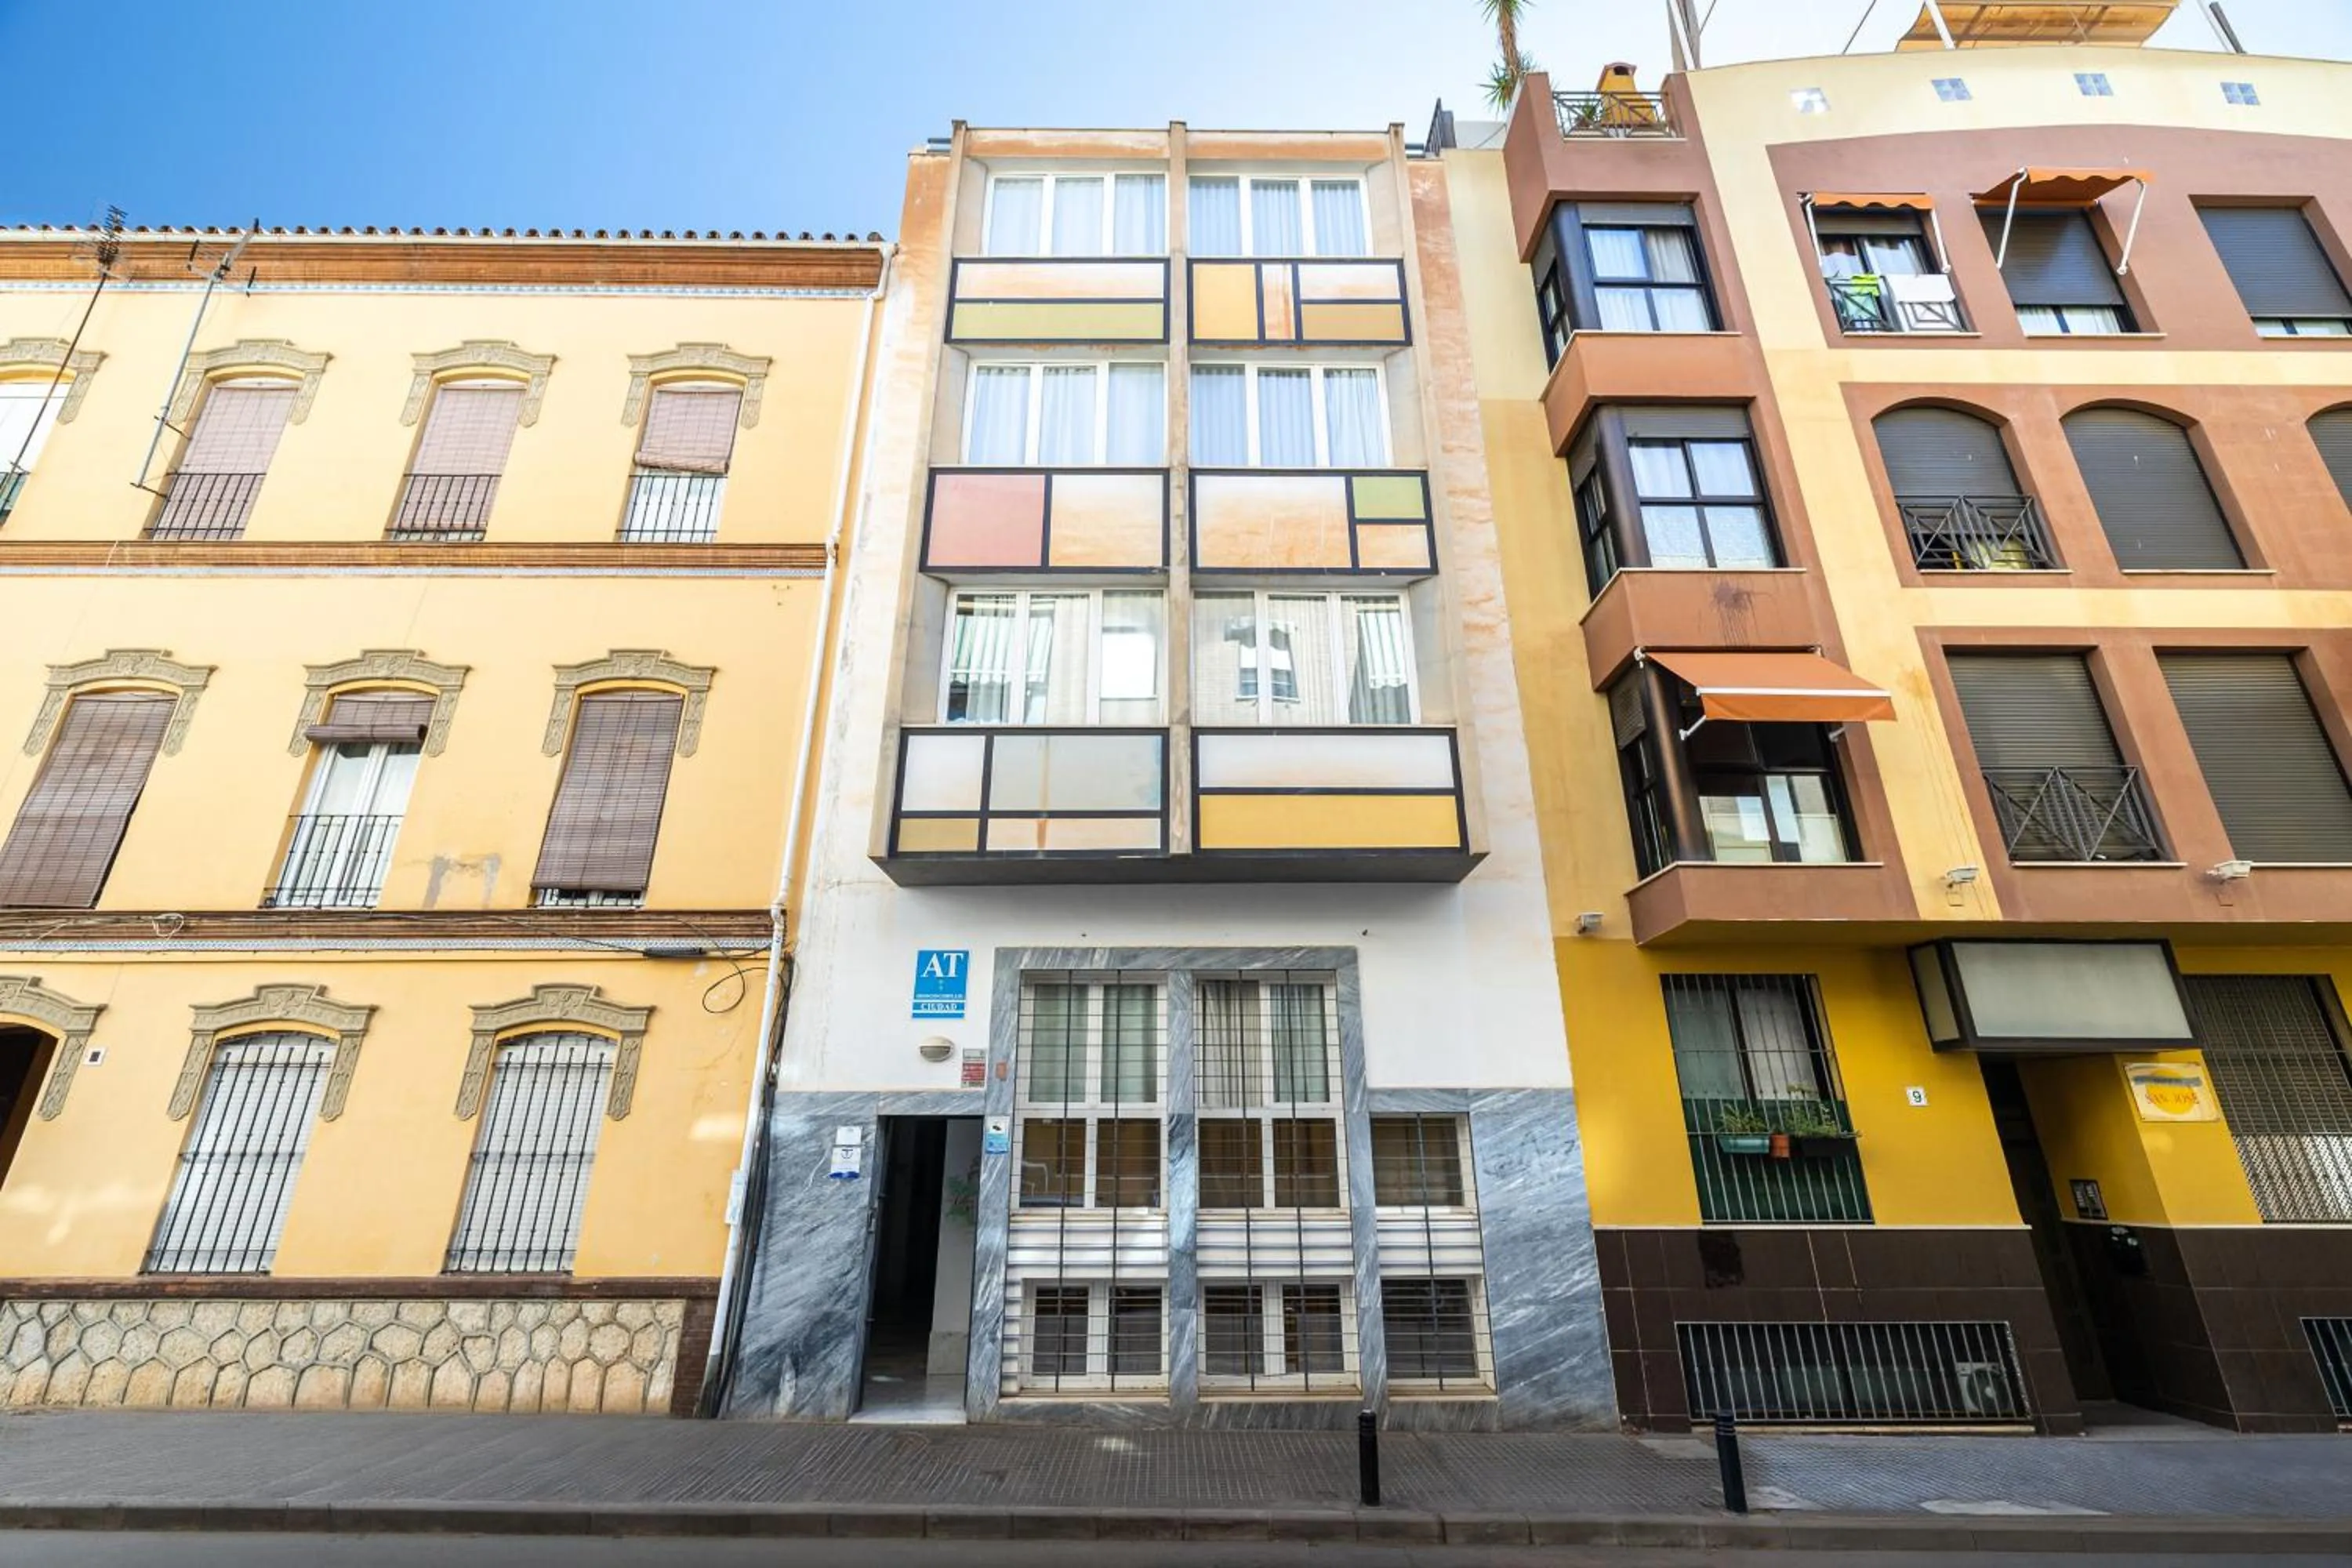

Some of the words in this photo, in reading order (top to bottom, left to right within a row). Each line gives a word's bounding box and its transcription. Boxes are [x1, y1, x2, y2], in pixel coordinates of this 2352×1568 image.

[921, 953, 964, 978] AT
[920, 1003, 957, 1011] CIUDAD
[1912, 1091, 1922, 1103] 9
